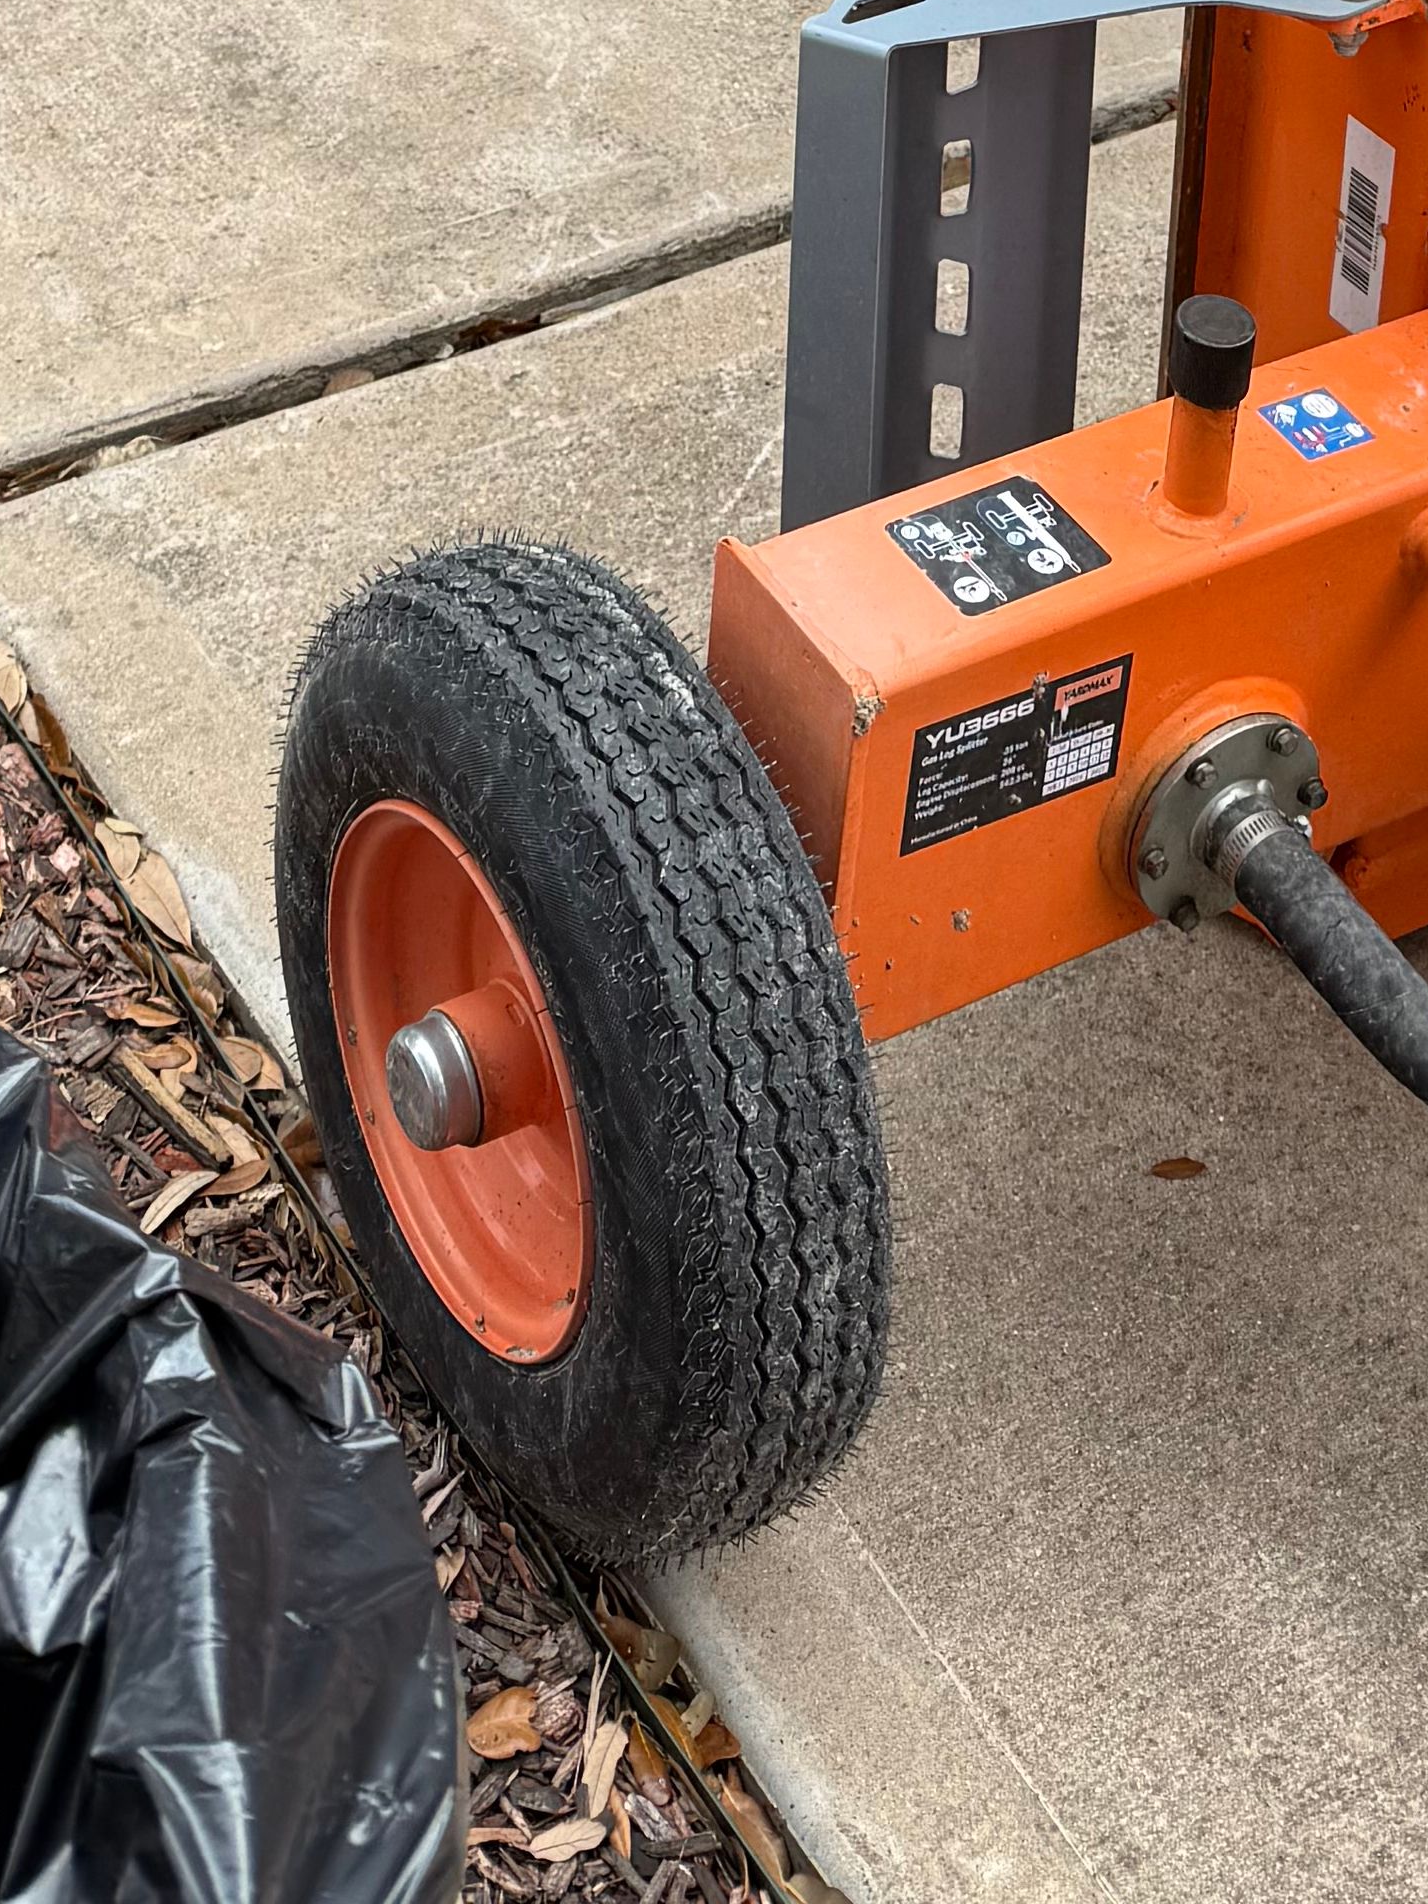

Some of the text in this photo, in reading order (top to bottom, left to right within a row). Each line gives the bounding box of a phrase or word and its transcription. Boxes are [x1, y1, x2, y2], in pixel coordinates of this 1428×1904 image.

[1063, 674, 1115, 701] YARDMAX
[925, 697, 1036, 749] YU3666
[921, 735, 989, 768] Gas Log Splitter
